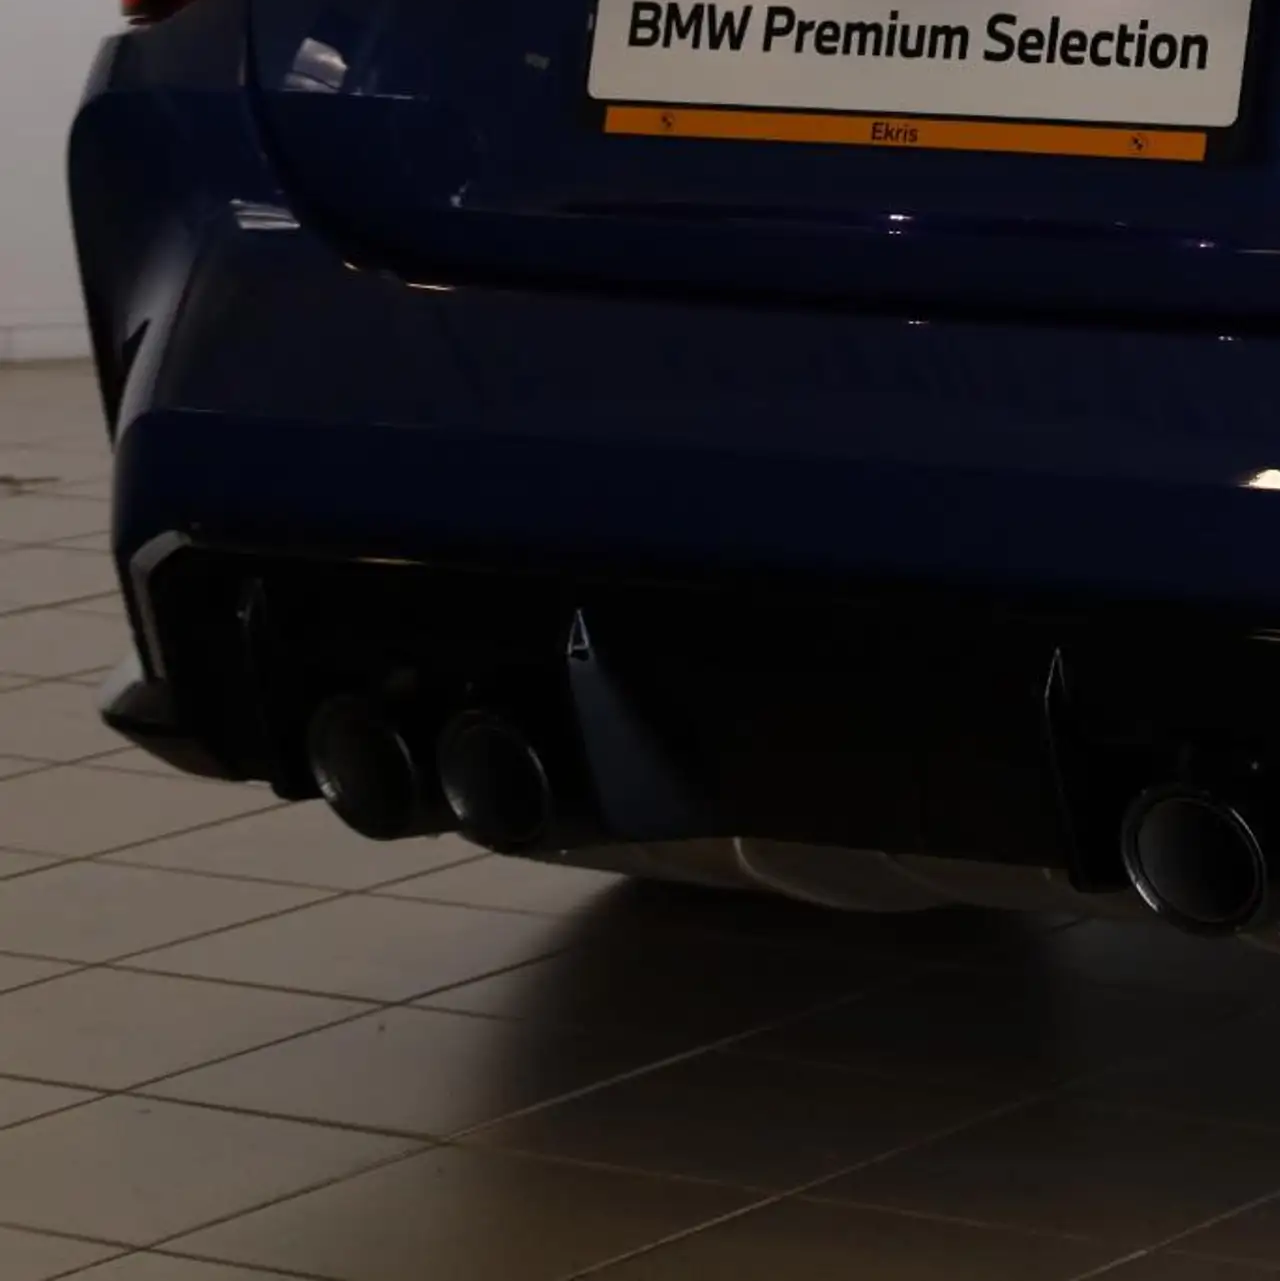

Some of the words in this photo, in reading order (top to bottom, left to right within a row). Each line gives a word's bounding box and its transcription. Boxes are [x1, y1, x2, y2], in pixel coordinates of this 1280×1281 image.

[628, 1, 753, 51] BMW
[763, 6, 969, 60] Premium
[984, 13, 1209, 70] Selection
[871, 122, 918, 143] Ekris
